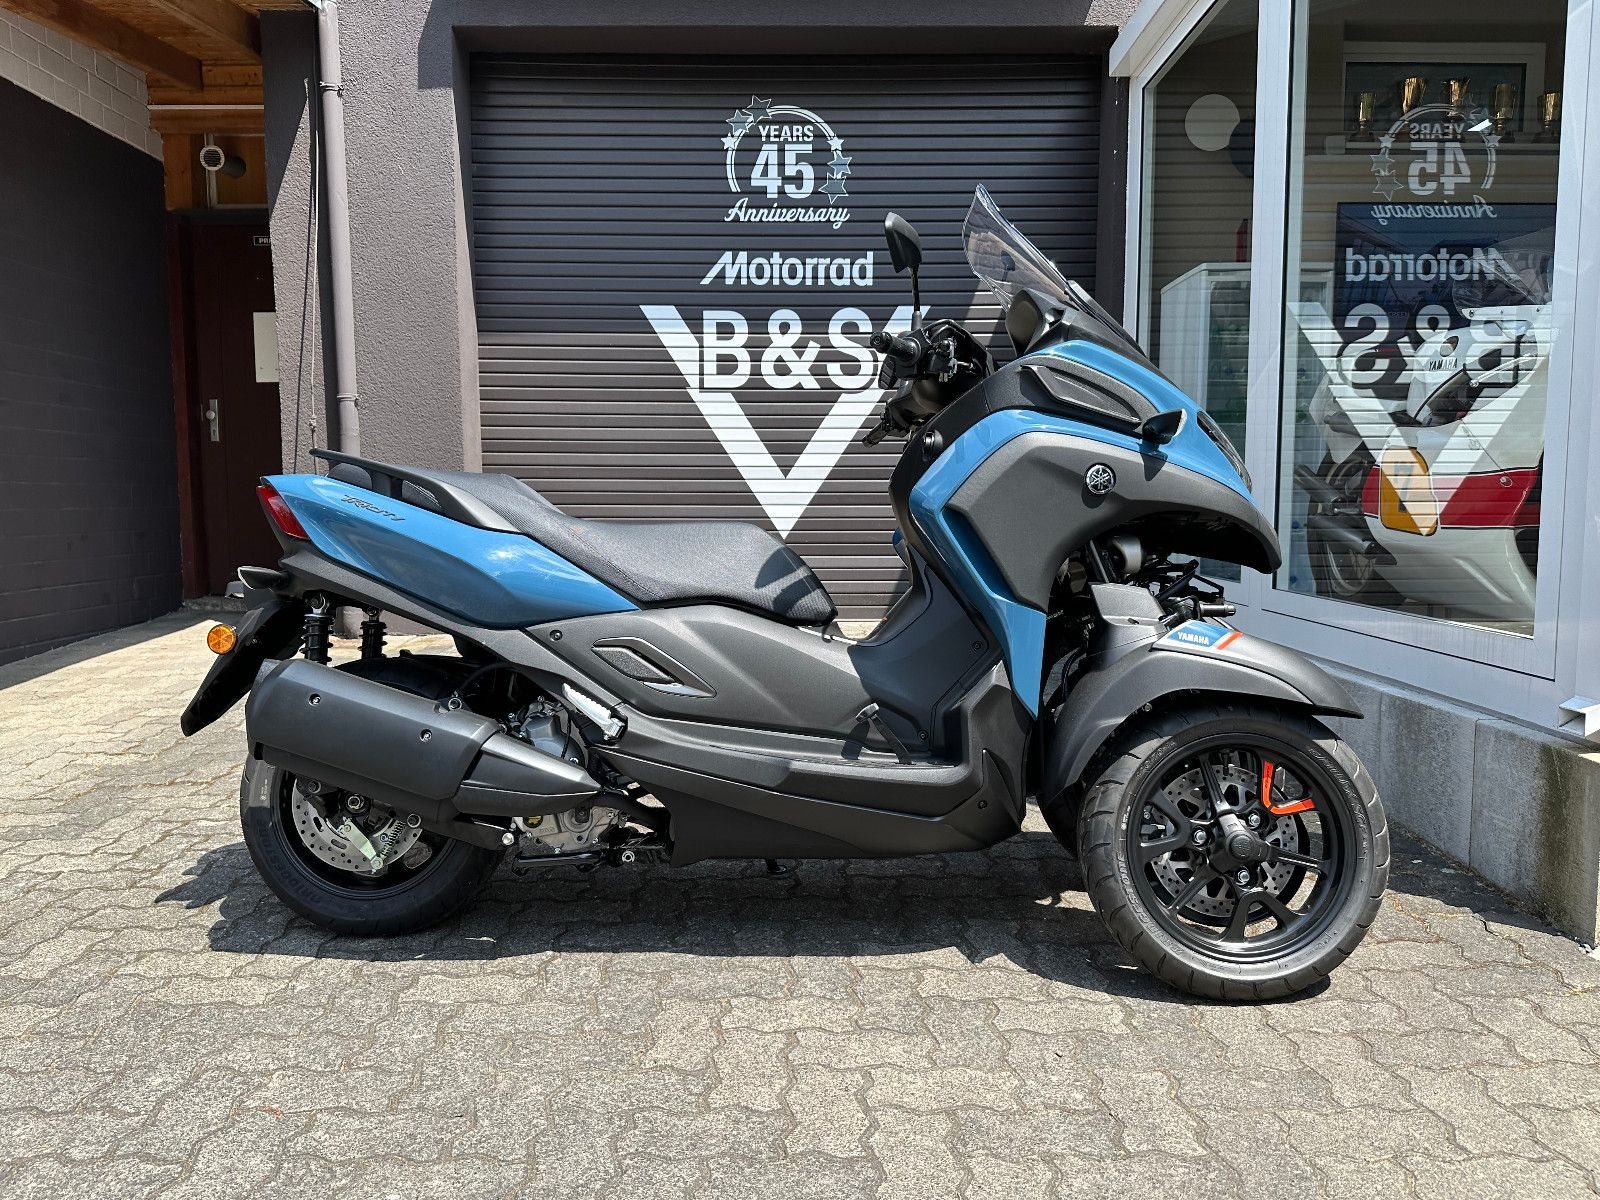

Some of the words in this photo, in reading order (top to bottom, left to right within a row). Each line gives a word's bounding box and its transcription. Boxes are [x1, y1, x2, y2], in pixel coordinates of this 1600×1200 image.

[758, 125, 814, 142] YEARS
[751, 144, 815, 199] 45
[724, 197, 851, 229] Anniversary
[700, 251, 874, 286] Motorrad
[703, 307, 875, 390] B&S
[1429, 358, 1458, 371] YAMAHA
[1177, 631, 1210, 646] YAMAHA
